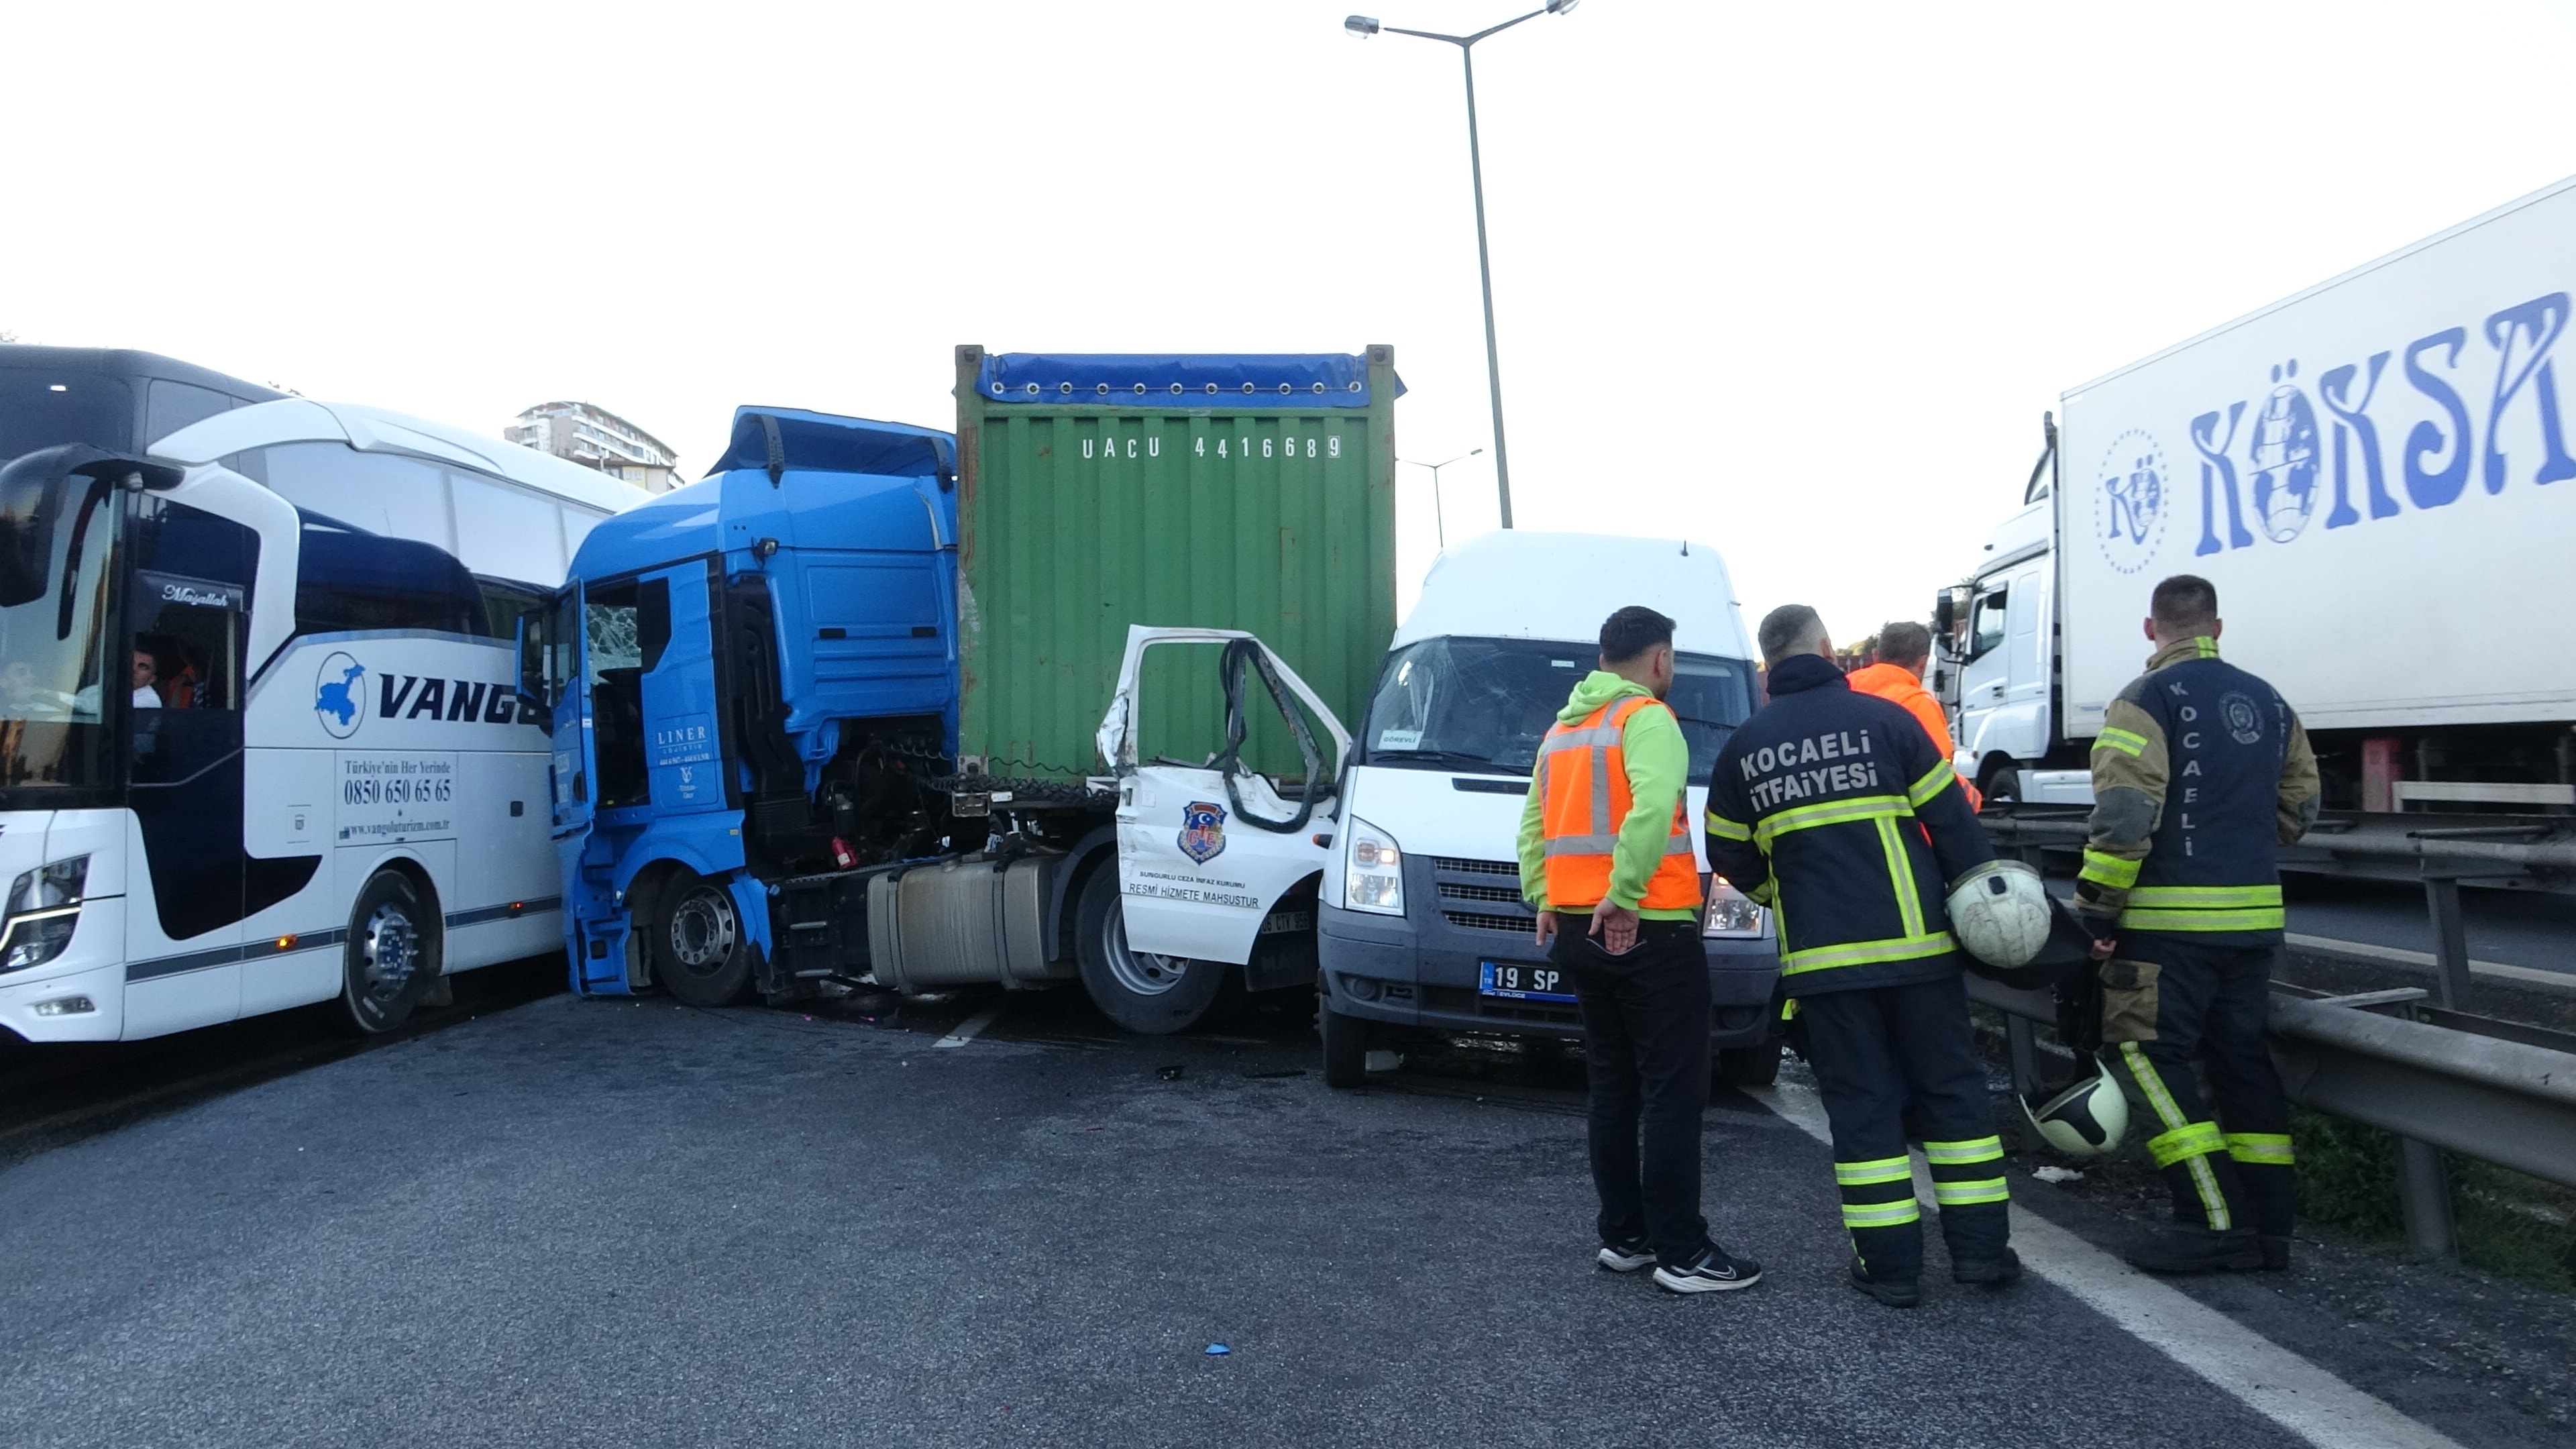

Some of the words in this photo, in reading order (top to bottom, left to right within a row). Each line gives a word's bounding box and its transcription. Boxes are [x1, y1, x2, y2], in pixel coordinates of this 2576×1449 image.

[1082, 437, 1160, 459] UACU
[1195, 436, 1340, 459] 4416689
[658, 726, 706, 745] LINER
[345, 760, 399, 777] Türkiye'nin
[402, 761, 417, 773] Her
[420, 761, 451, 773] Yerinde
[345, 780, 380, 805] 0850
[385, 779, 411, 803] 650
[415, 779, 431, 802] 65
[435, 779, 451, 802] 65
[1140, 871, 1176, 881] SUNGURLU
[1195, 876, 1215, 885] İNFAZ
[1216, 879, 1246, 889] KURUMU
[1129, 883, 1158, 895] RESMİ
[1161, 885, 1200, 900] HİZMETE
[1203, 891, 1259, 907] MAHSUSTUR
[1495, 967, 1518, 988] 19
[1534, 969, 1559, 991] SP
